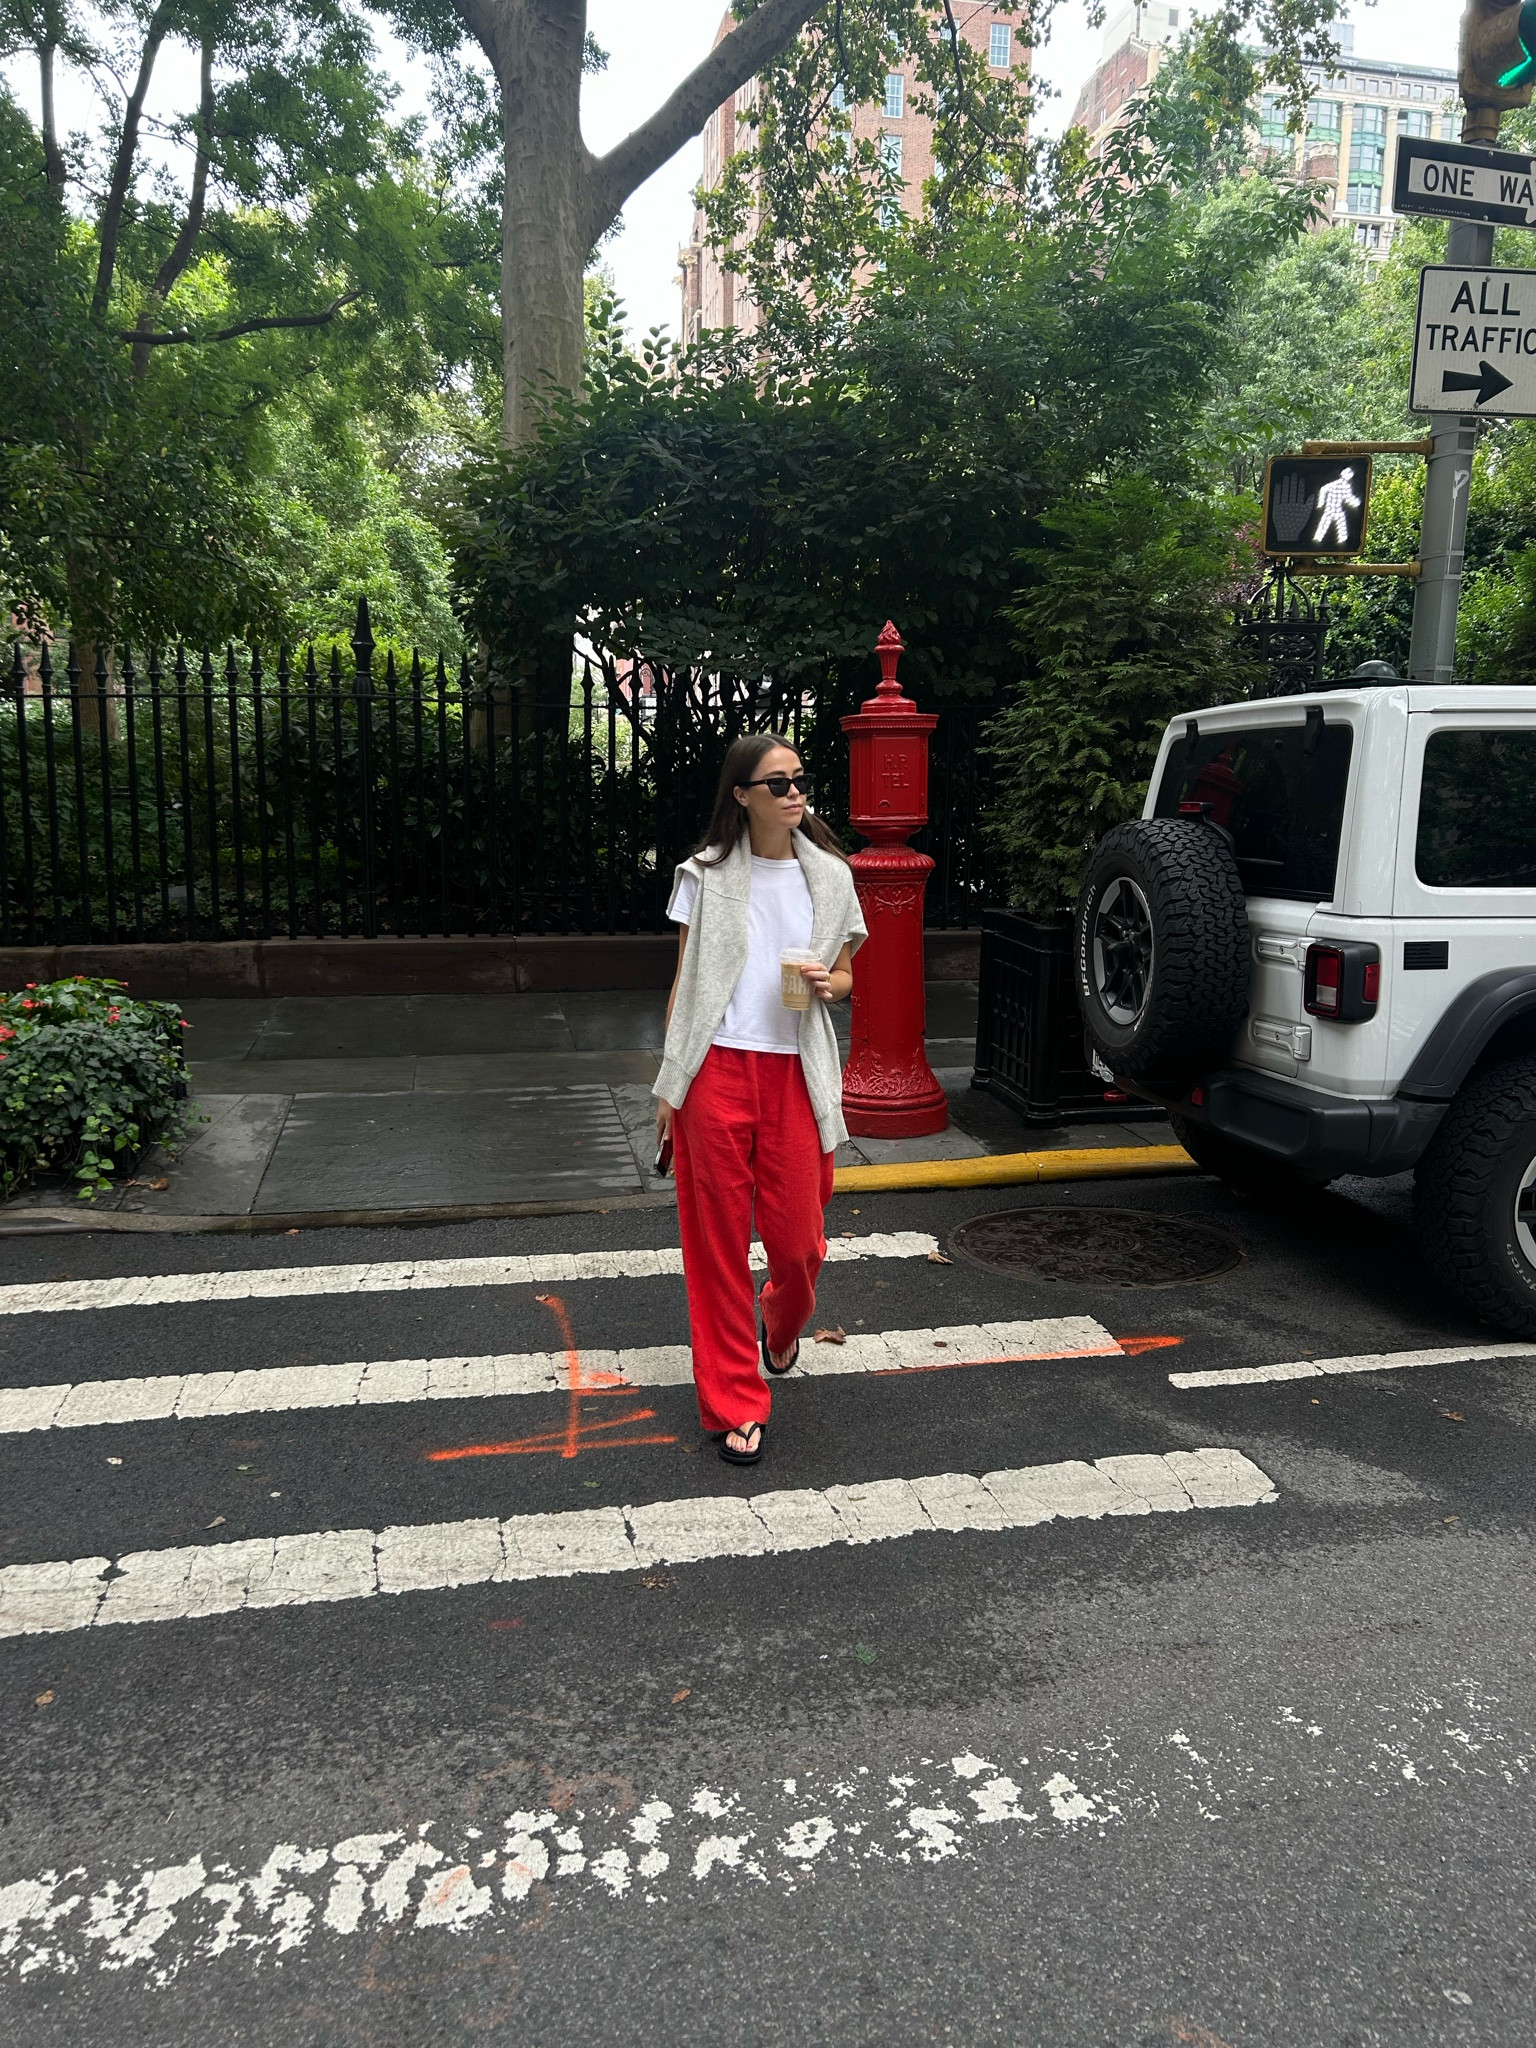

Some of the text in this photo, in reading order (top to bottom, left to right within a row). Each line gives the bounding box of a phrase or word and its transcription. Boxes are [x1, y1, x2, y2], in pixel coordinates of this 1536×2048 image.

[1423, 163, 1536, 206] ONE WA
[1450, 280, 1521, 316] ALL
[1426, 323, 1536, 355] TRAFFIC
[881, 772, 910, 788] TEL
[1080, 885, 1096, 996] BFGoodrich
